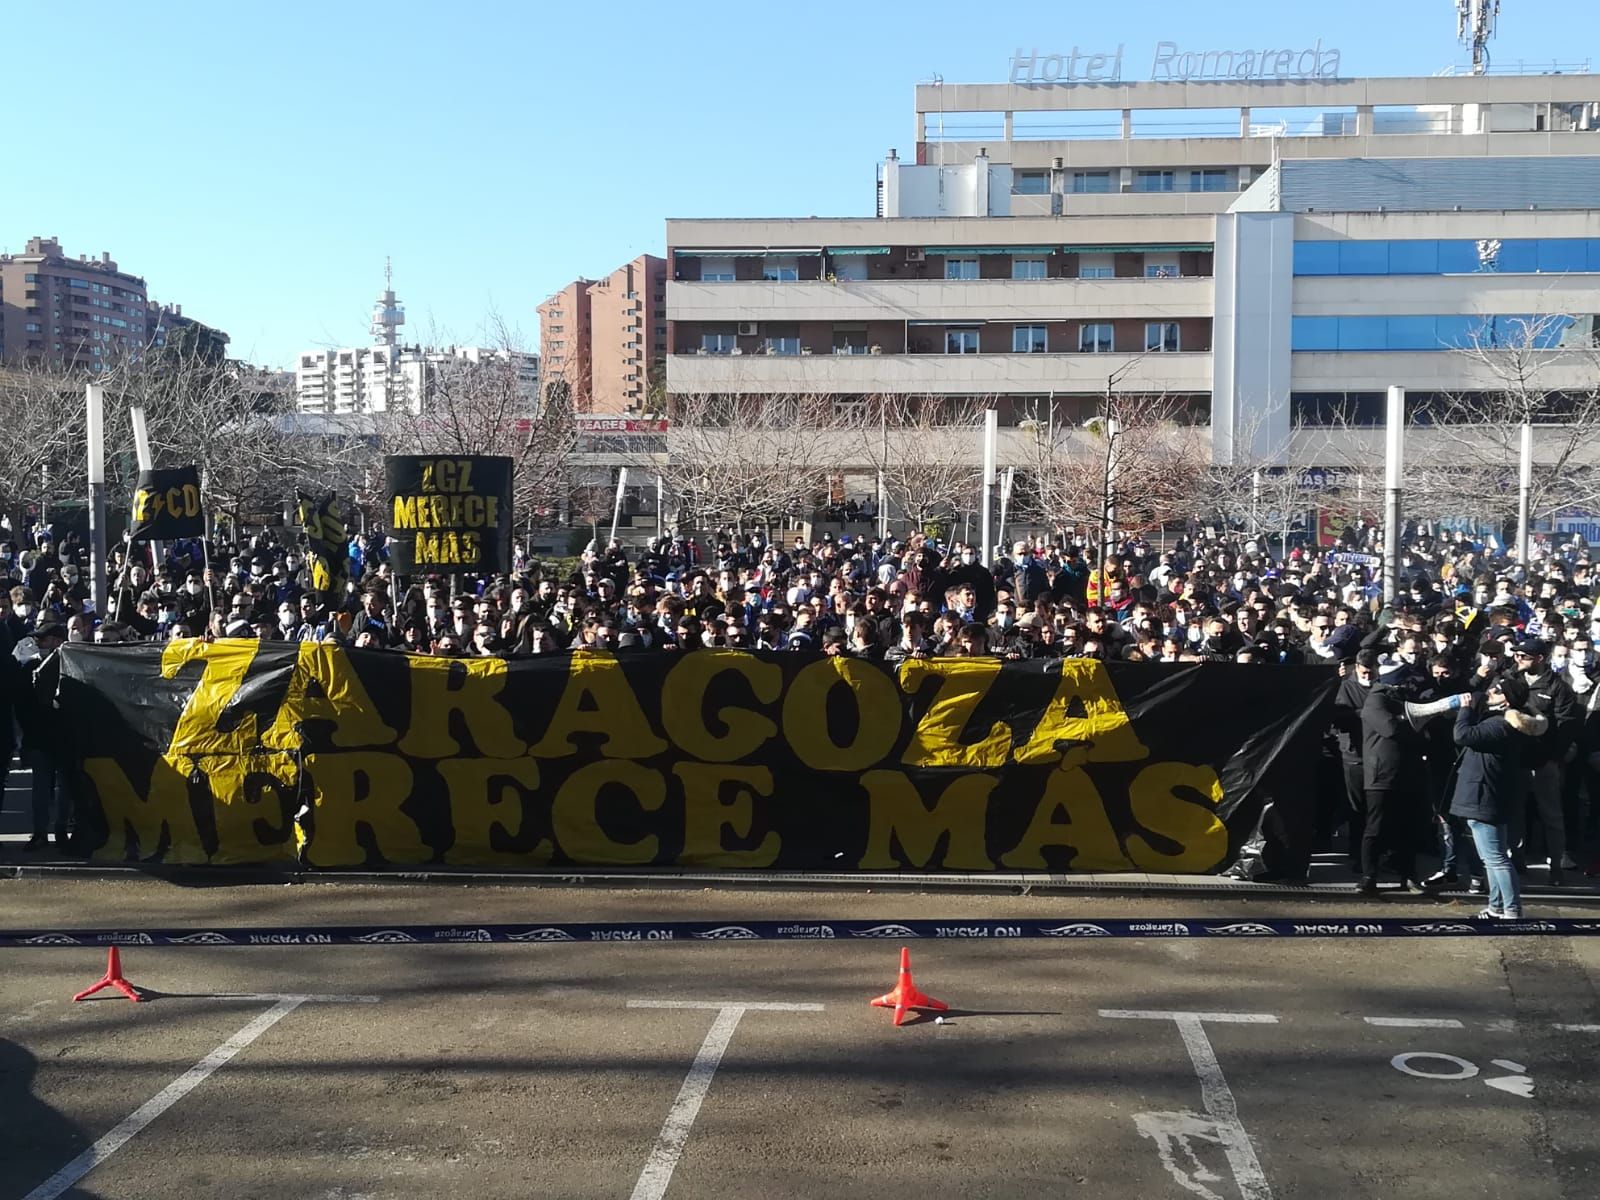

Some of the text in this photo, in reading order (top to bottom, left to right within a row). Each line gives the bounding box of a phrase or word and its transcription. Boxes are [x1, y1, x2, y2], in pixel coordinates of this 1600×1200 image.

[1009, 38, 1341, 82] Hotel Romareda
[419, 459, 474, 493] ZGZ
[393, 495, 499, 529] MERECE
[161, 636, 1150, 771] ZARAGOZA
[84, 747, 1229, 874] MERECE MÁS
[777, 924, 820, 936] Zaragoza
[935, 927, 1022, 938] NO PASAR
[1129, 922, 1174, 933] Zaragoza
[1293, 924, 1383, 935] NO PASAR
[97, 931, 138, 942] Zaragoza
[249, 934, 332, 944] NO PASAR
[434, 928, 477, 939] Zaragoza
[590, 930, 674, 941] NO PASAR
